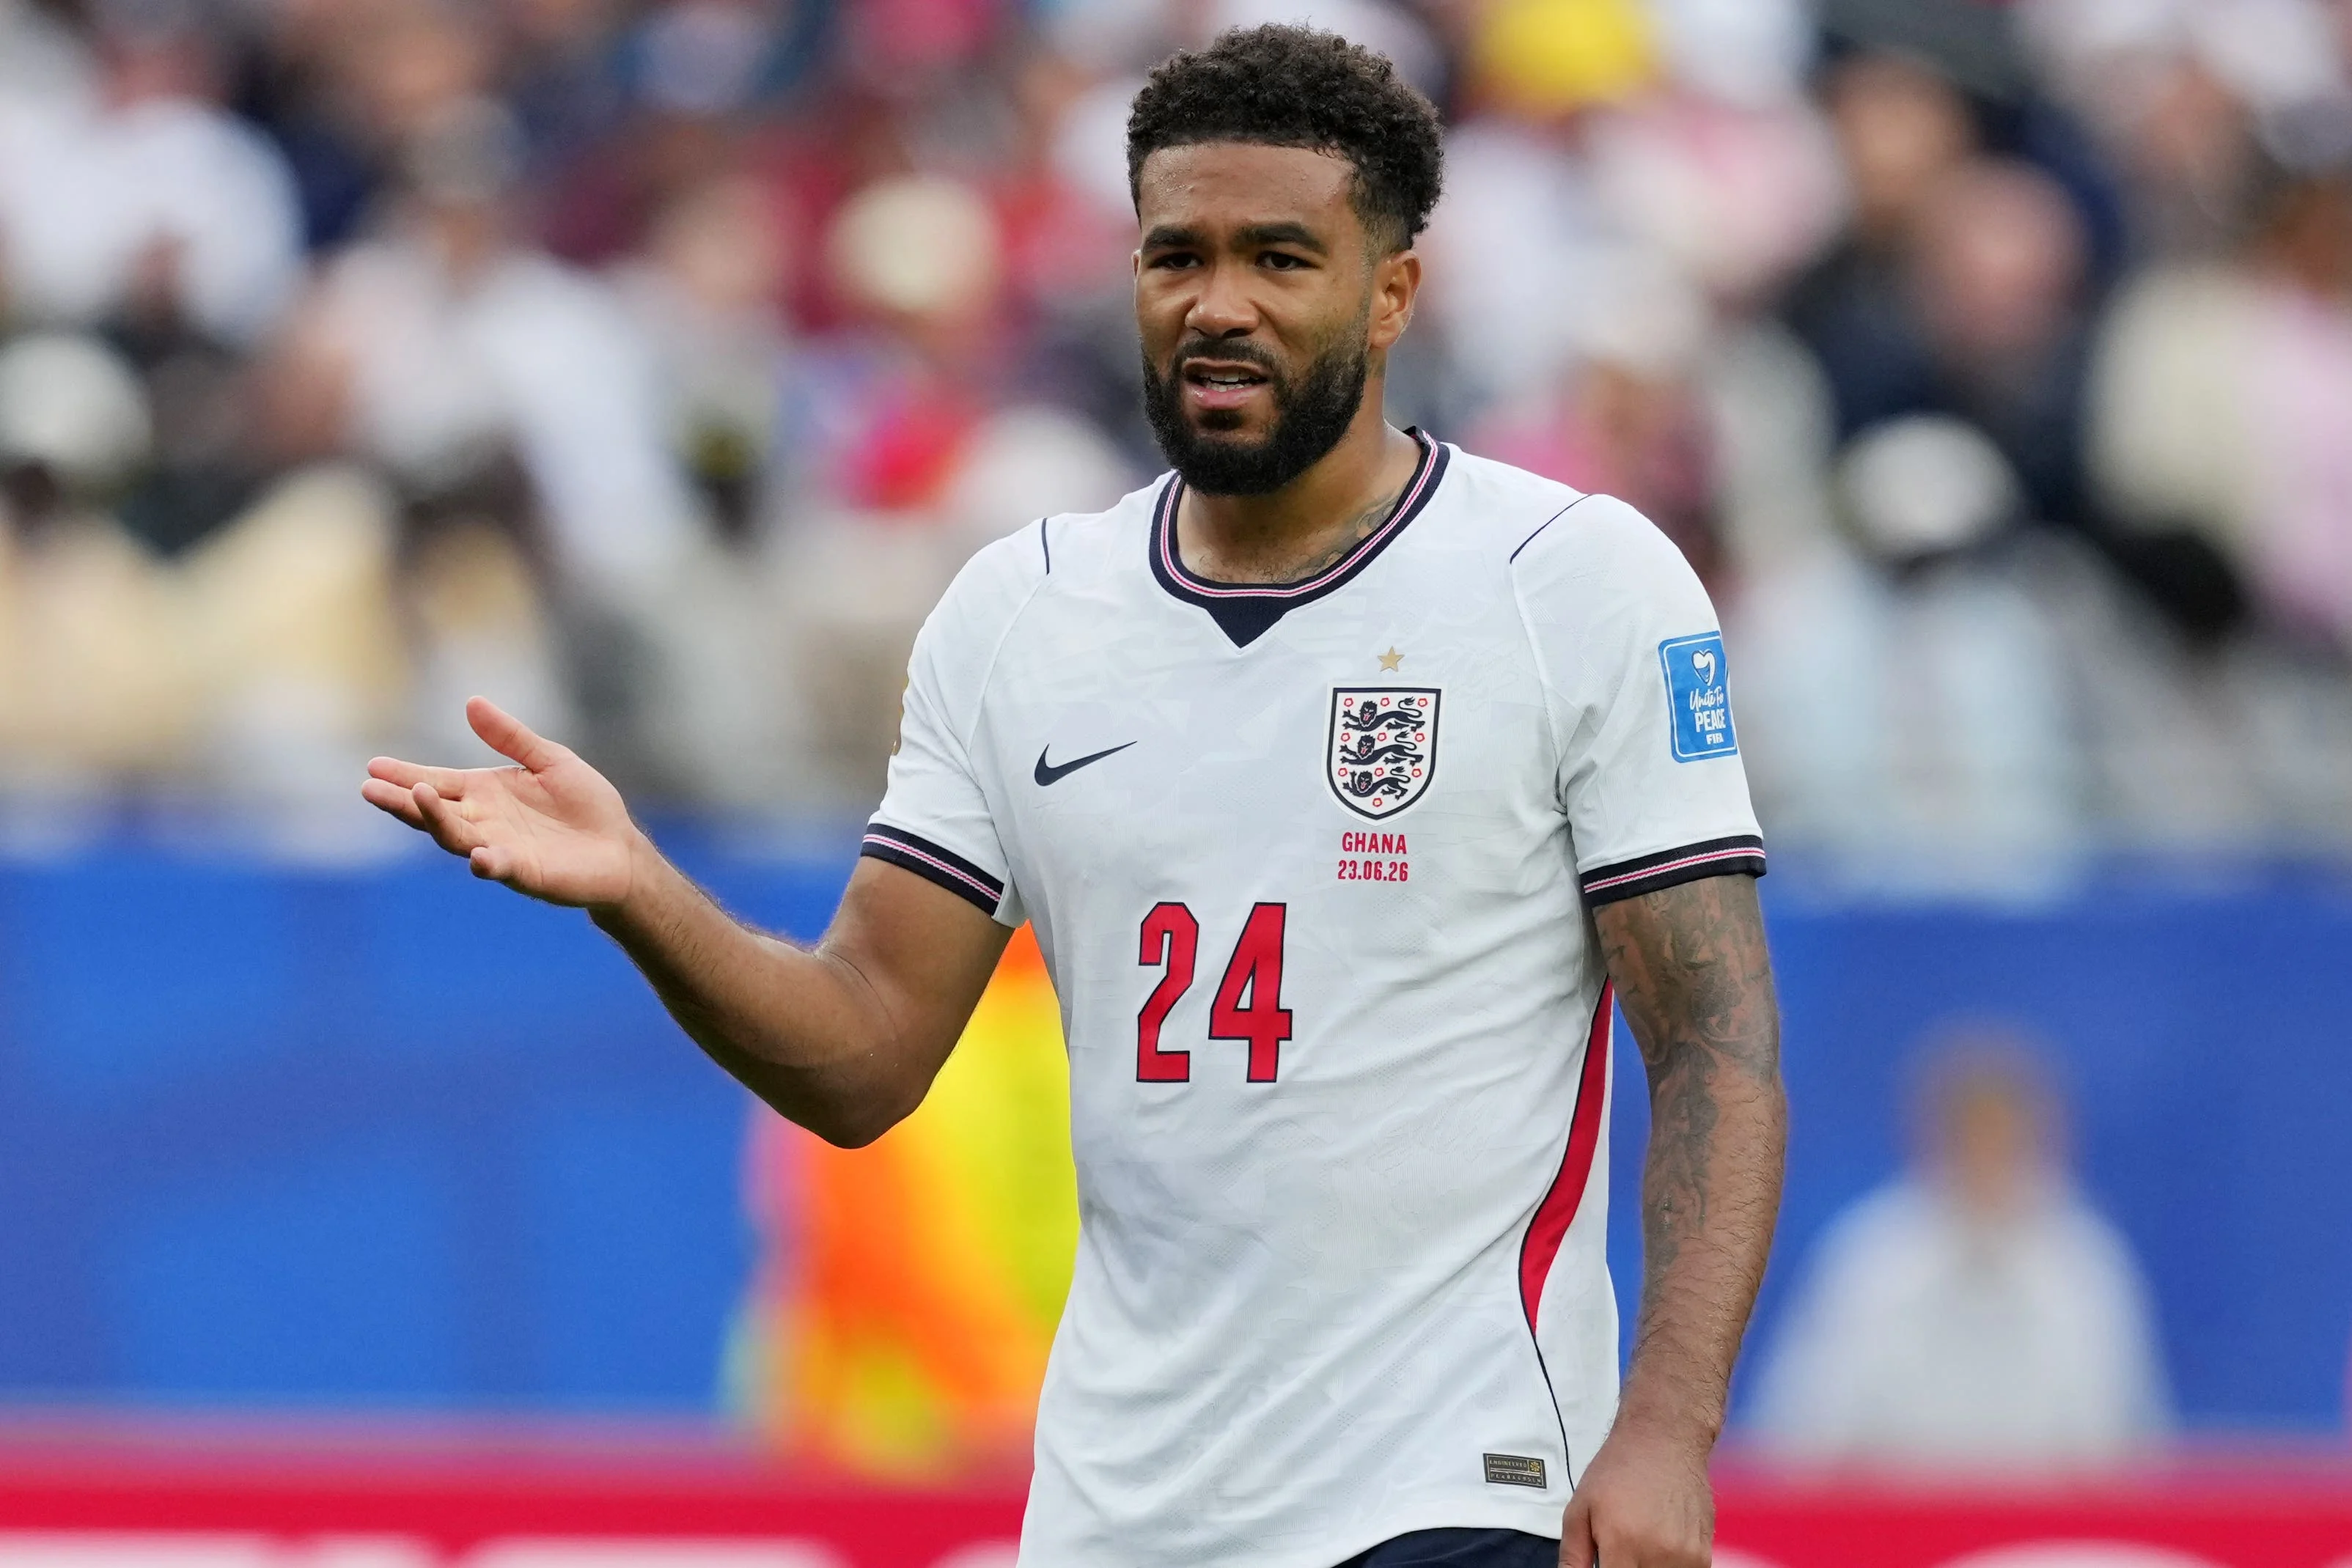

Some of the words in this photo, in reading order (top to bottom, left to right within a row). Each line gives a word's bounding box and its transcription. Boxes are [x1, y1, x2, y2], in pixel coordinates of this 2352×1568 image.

[1689, 688, 1716, 712] Unite
[1694, 708, 1727, 733] PEACE
[1342, 831, 1408, 855] GHANA
[1337, 859, 1408, 882] 23.06.26
[1136, 901, 1293, 1083] 24
